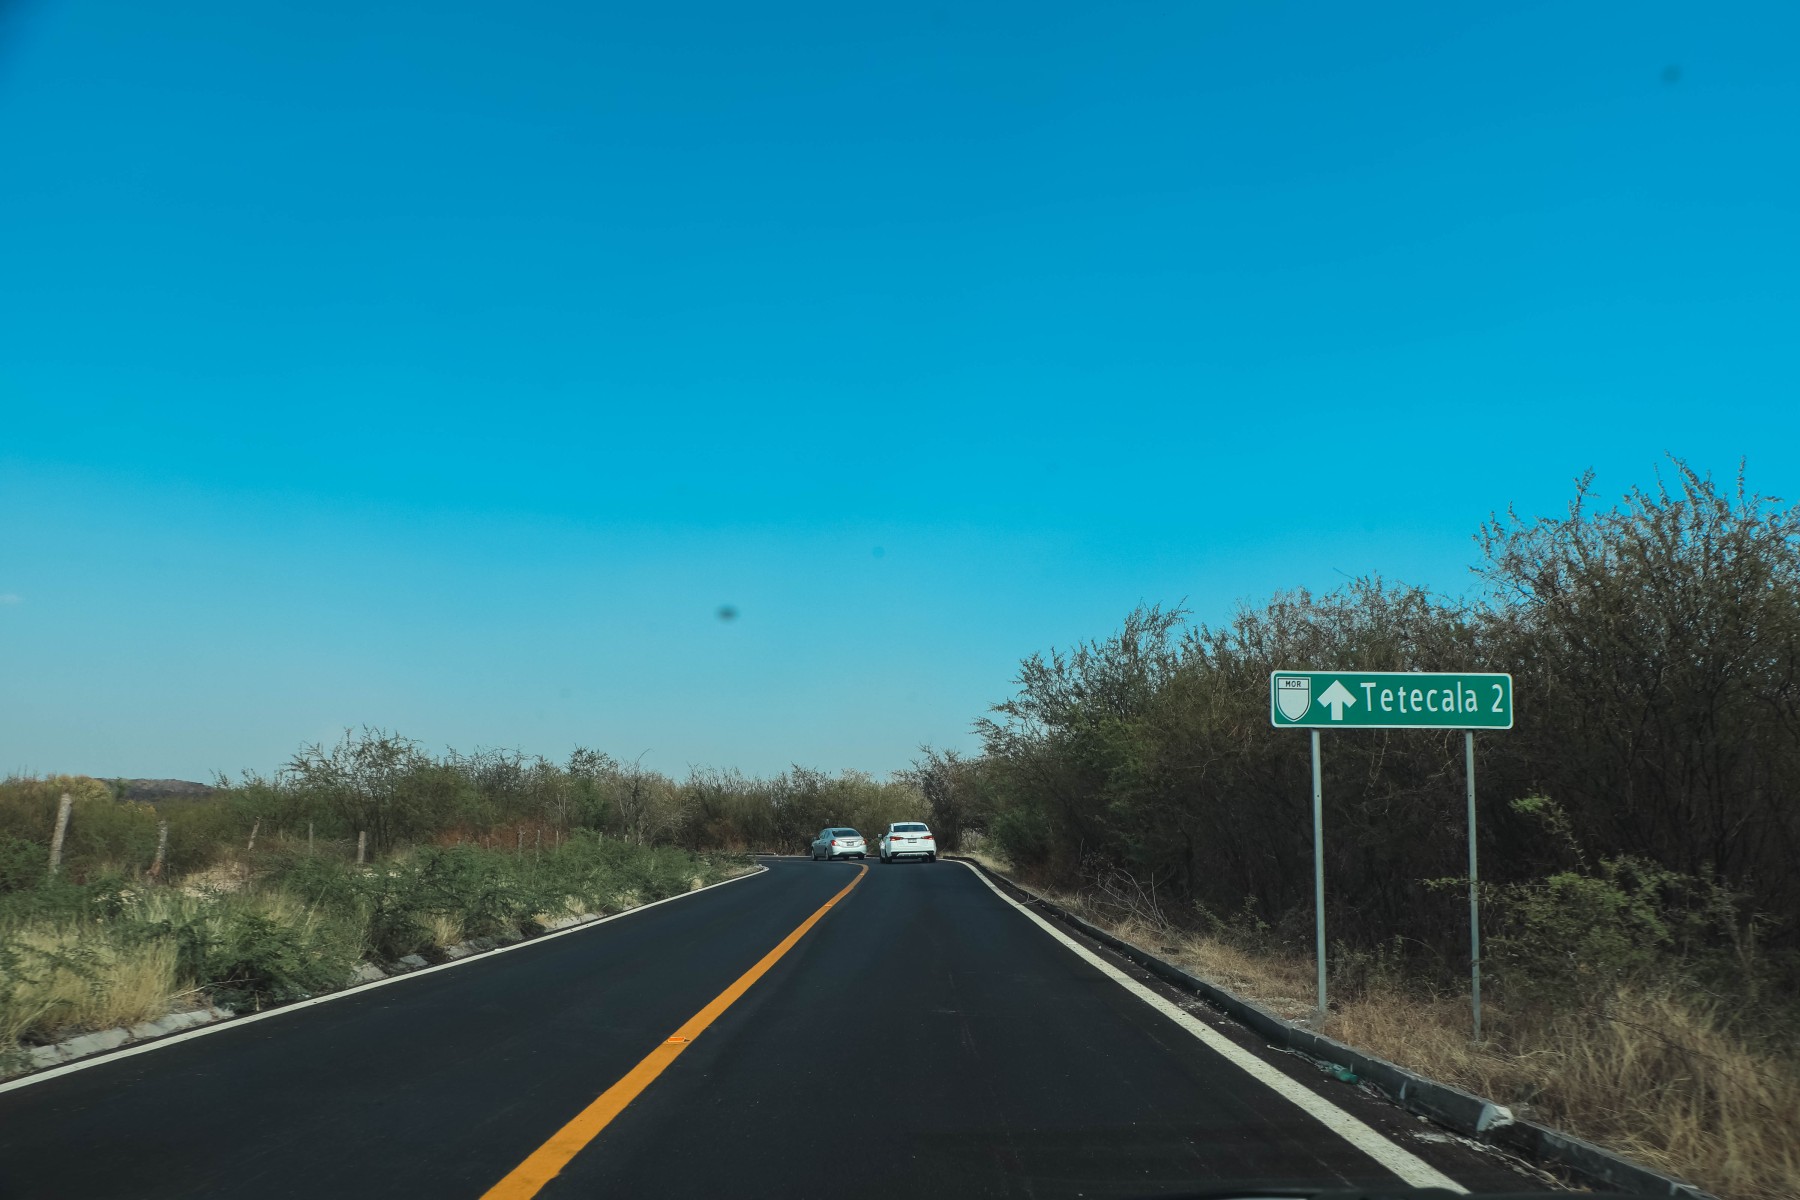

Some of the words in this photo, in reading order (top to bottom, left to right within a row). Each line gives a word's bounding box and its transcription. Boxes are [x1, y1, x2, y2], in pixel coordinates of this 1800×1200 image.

[1285, 680, 1302, 688] MOR
[1360, 681, 1478, 714] Tetecala
[1491, 683, 1504, 713] 2
